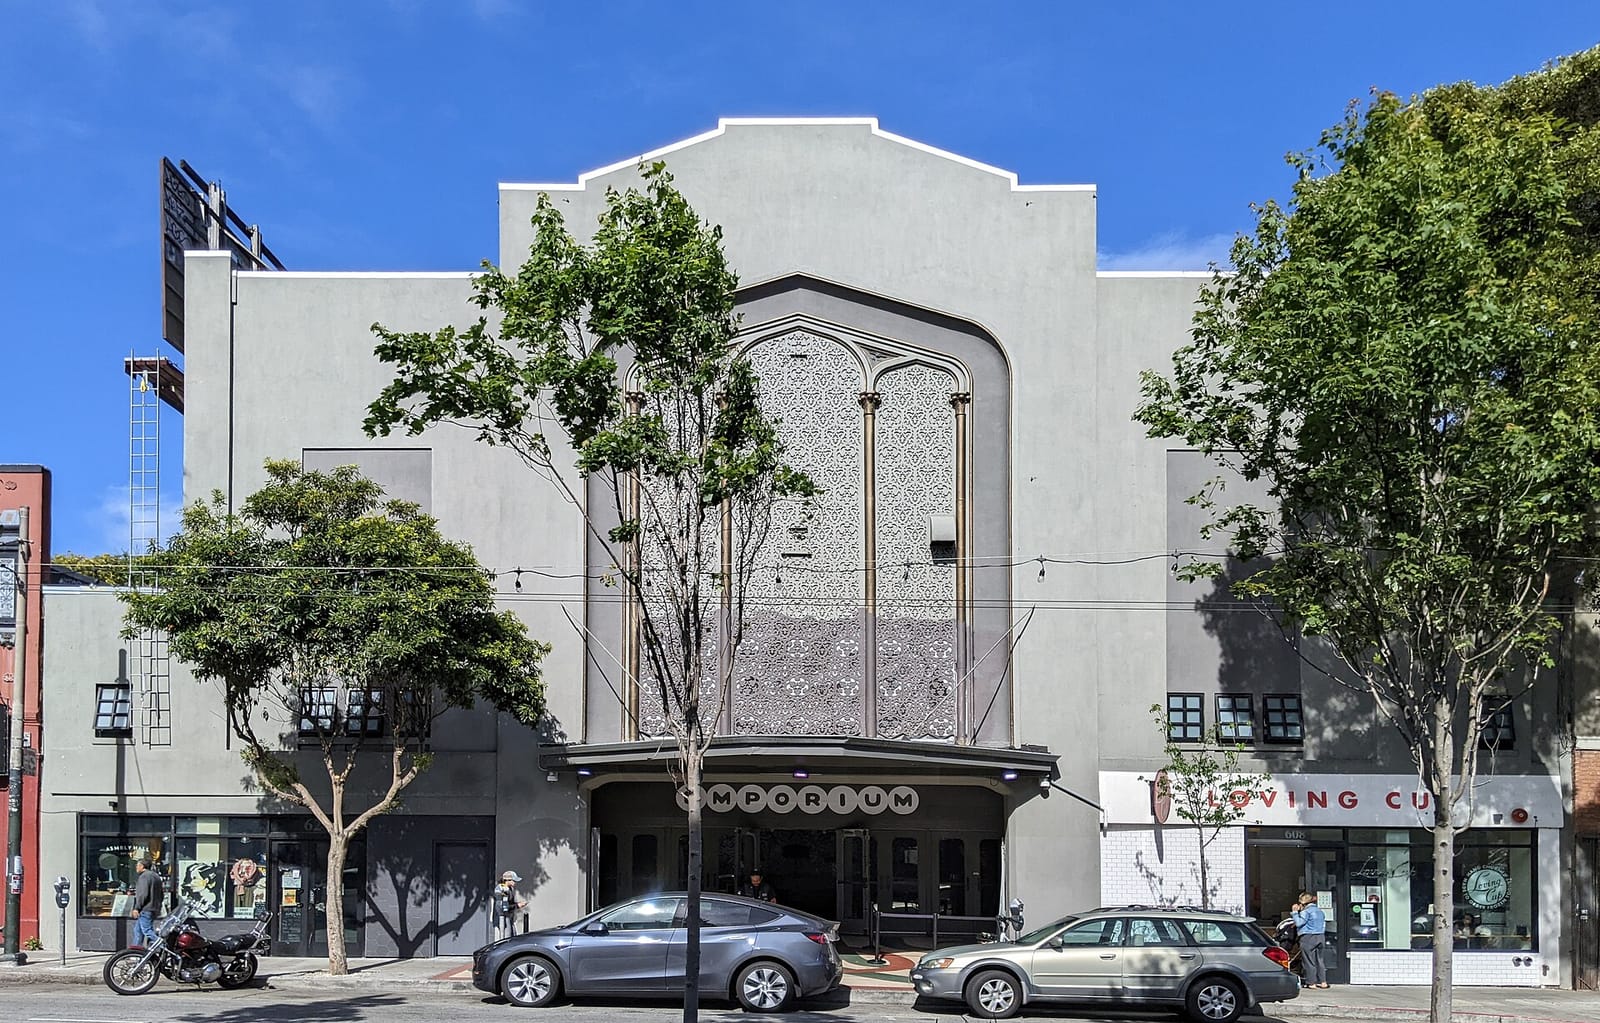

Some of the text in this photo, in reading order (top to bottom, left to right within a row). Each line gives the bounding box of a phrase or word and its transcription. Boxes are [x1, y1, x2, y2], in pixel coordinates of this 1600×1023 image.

[1207, 790, 1430, 810] LOVING CU
[1470, 870, 1504, 893] Loving
[1485, 887, 1503, 903] Cup
